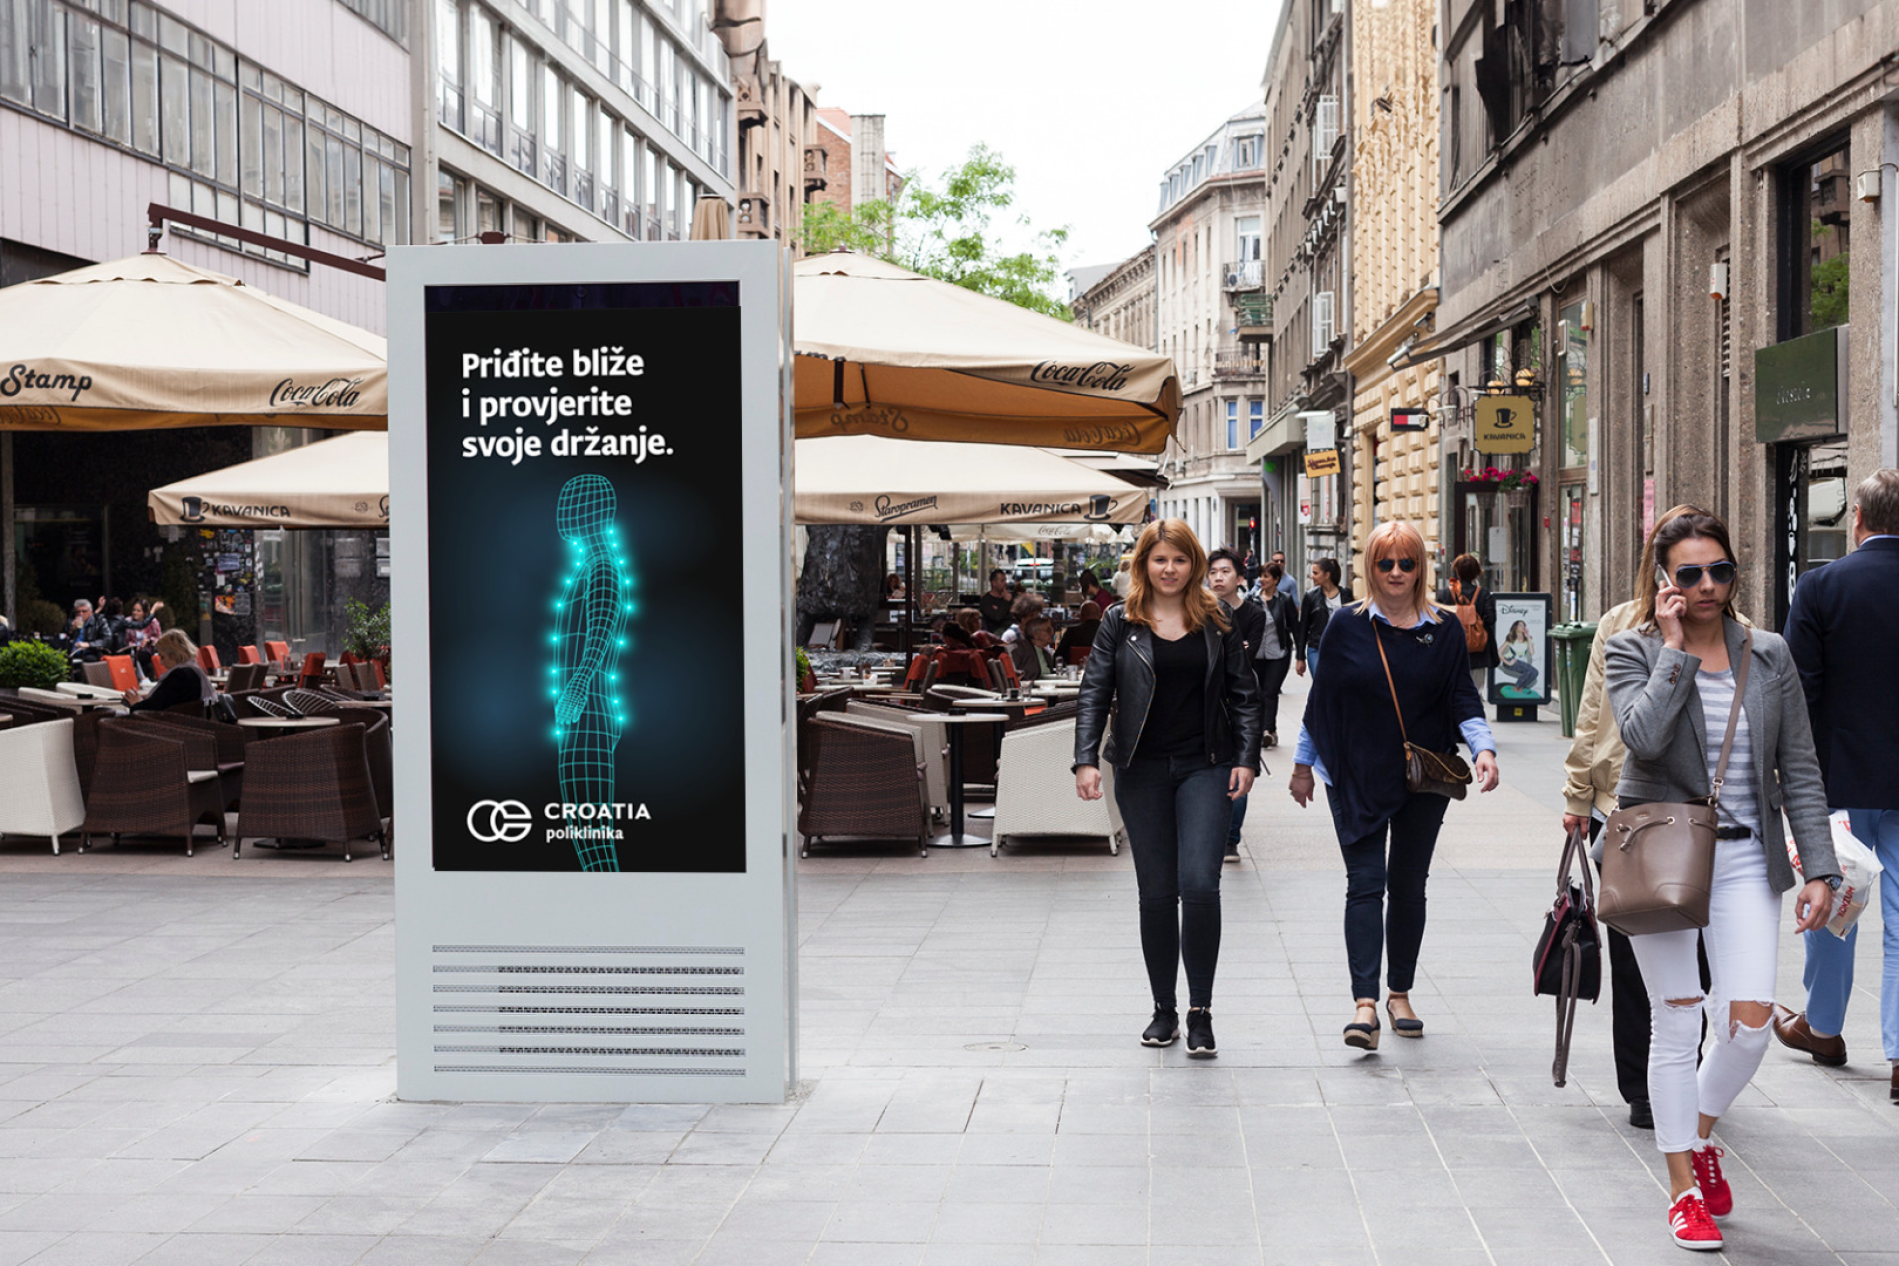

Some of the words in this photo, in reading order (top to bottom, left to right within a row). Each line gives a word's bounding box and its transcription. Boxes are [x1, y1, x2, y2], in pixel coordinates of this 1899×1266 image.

[462, 348, 563, 378] Priđite
[572, 347, 644, 376] bliže
[0, 364, 93, 402] Stamp
[462, 388, 470, 418] i
[480, 386, 632, 426] provjerite
[462, 427, 542, 466] svoje
[551, 425, 674, 464] držanje.
[212, 505, 291, 518] KAVANICA
[875, 494, 938, 523] Staropramen
[1000, 503, 1082, 515] KAVANICA
[1498, 603, 1529, 617] Disney
[544, 803, 651, 820] CROATIA
[546, 825, 624, 843] poliklinika
